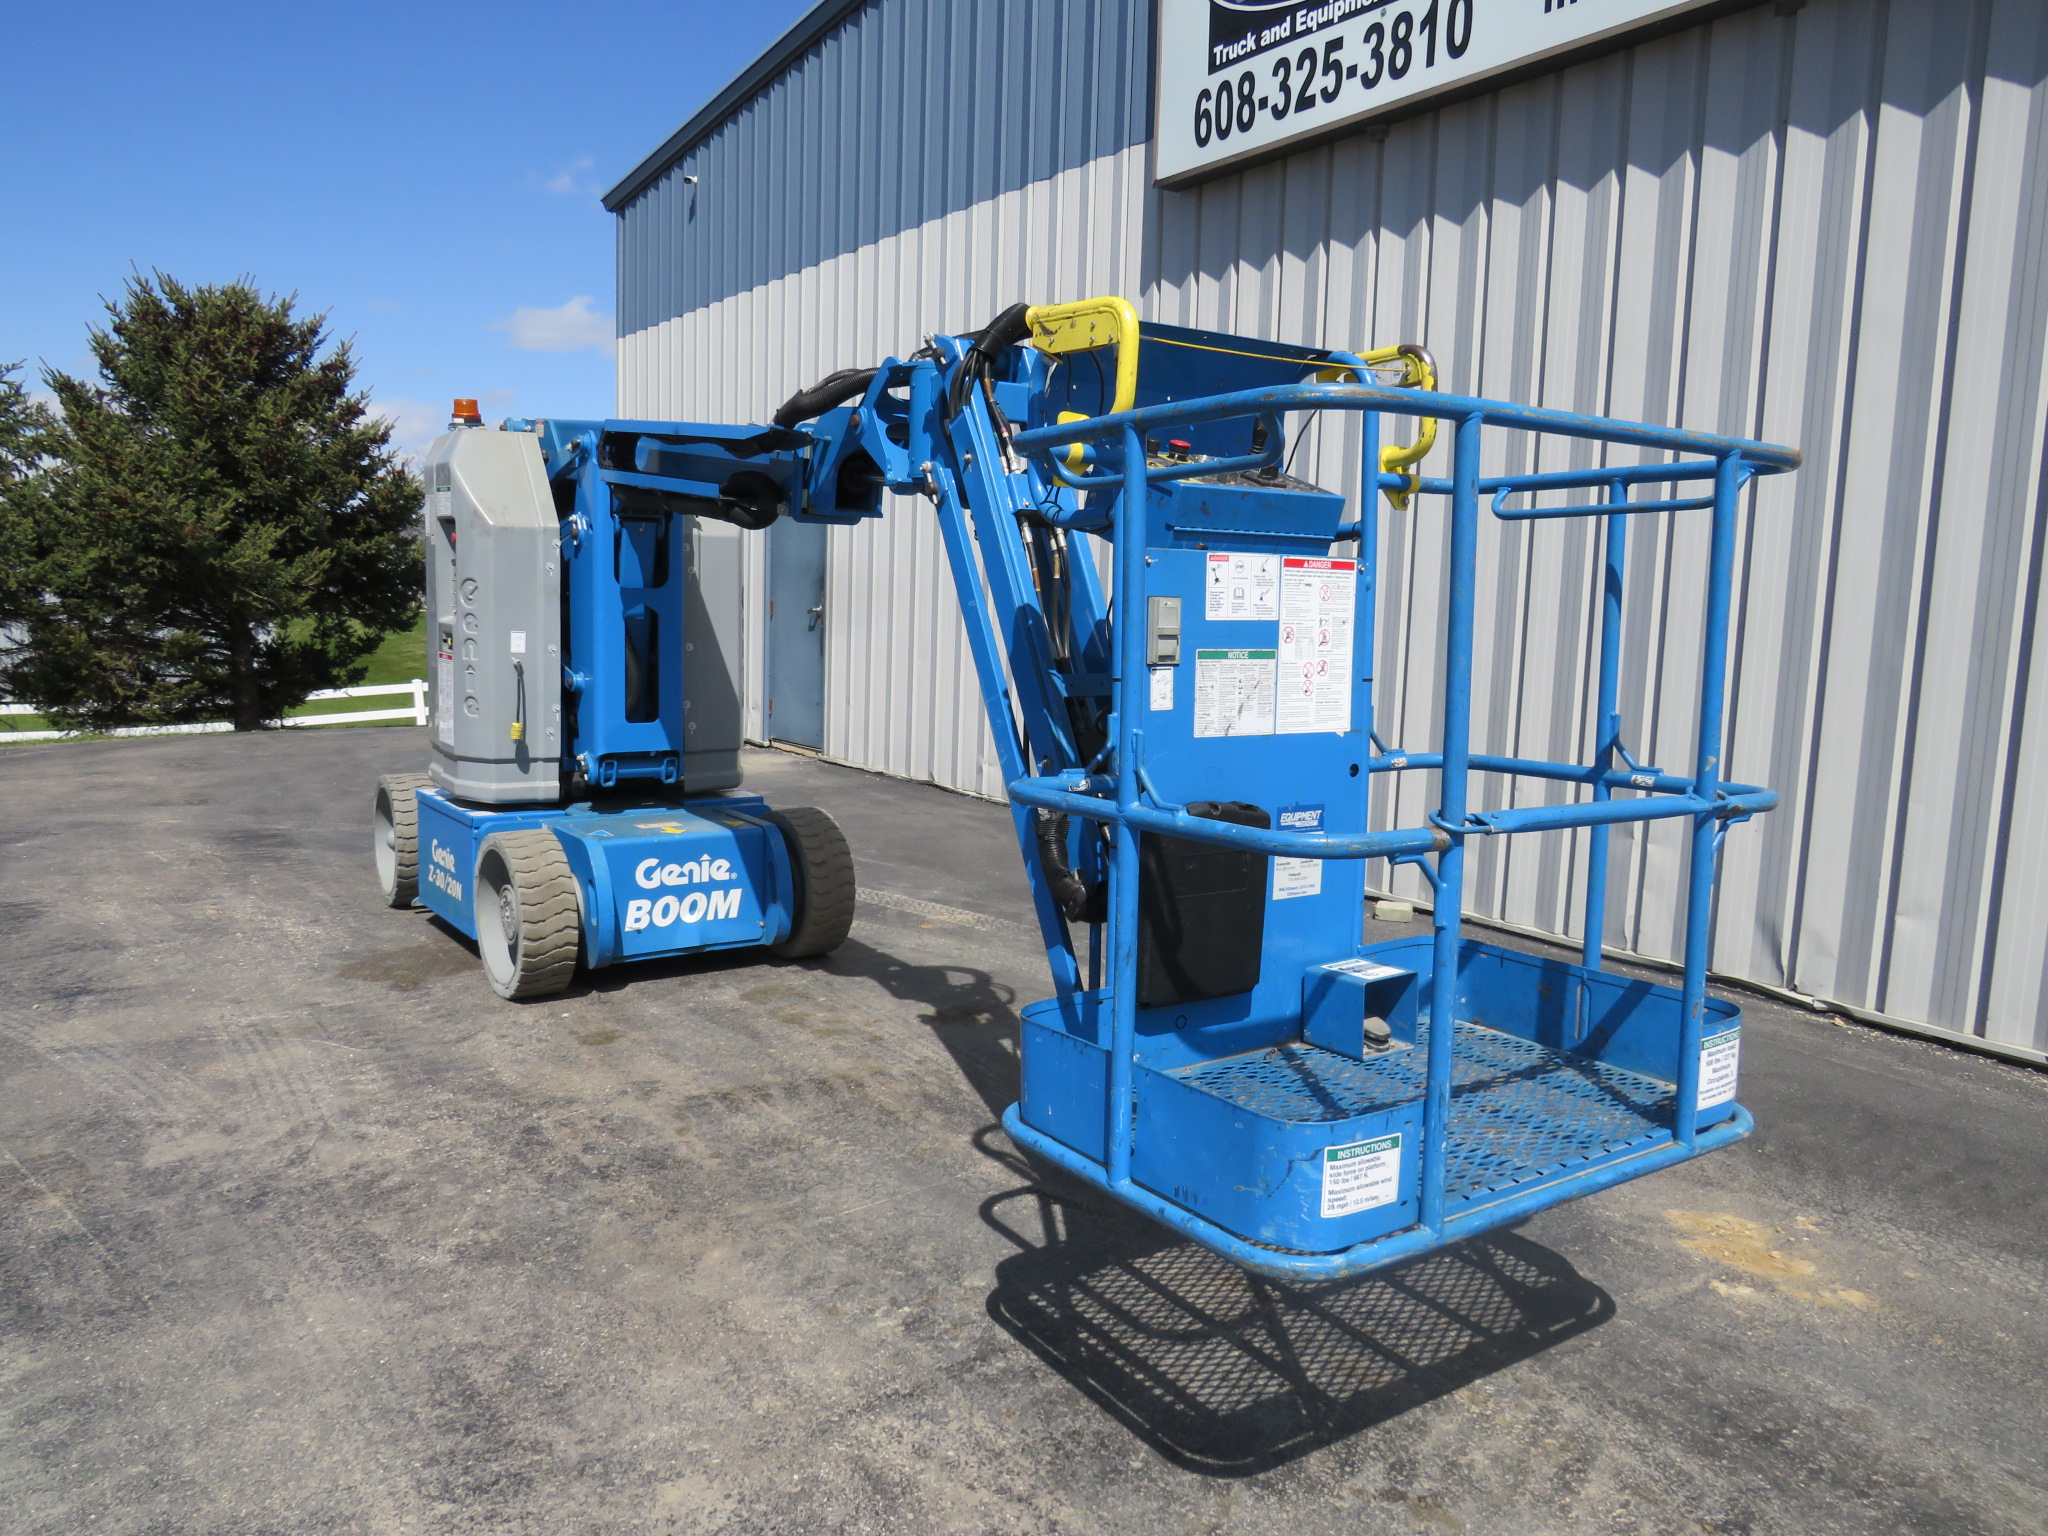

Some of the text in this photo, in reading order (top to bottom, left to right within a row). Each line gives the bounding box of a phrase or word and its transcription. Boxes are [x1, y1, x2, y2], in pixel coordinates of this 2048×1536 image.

[1213, 33, 1256, 66] Truck
[1260, 18, 1290, 48] and
[1194, 0, 1474, 149] 608-325-3810
[1308, 561, 1332, 569] DANGER
[1280, 810, 1322, 822] EQUIPMENT
[431, 838, 456, 874] Genie
[635, 853, 732, 889] Genie
[428, 864, 463, 901] Z-30/20N
[624, 887, 744, 933] BOOM
[1337, 1140, 1392, 1160] INSTRUCTIONS
[1329, 1155, 1381, 1171] Maximum allowable
[1343, 1168, 1357, 1176] force
[1327, 1176, 1393, 1196] Maximum allowable wind
[1329, 1178, 1340, 1186] 150
[1336, 1202, 1349, 1210] mph
